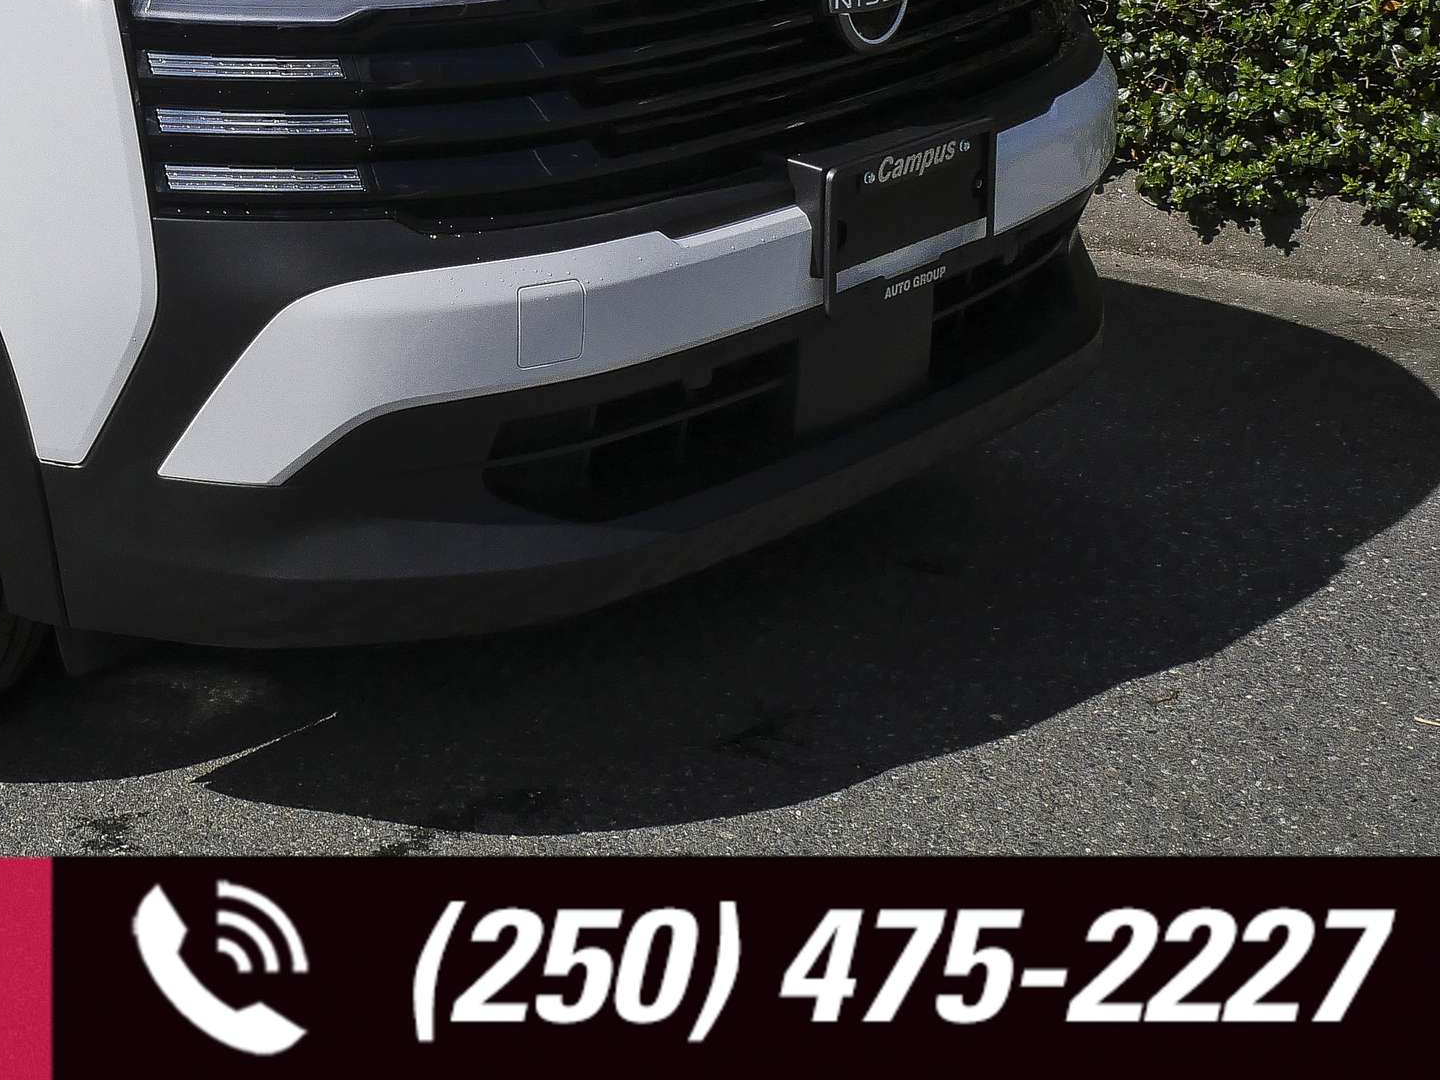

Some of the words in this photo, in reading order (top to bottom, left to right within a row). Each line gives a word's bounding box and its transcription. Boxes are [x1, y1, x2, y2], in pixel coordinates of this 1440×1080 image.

[877, 139, 957, 184] Campus
[884, 277, 911, 300] AUTO
[913, 266, 947, 290] GROUP
